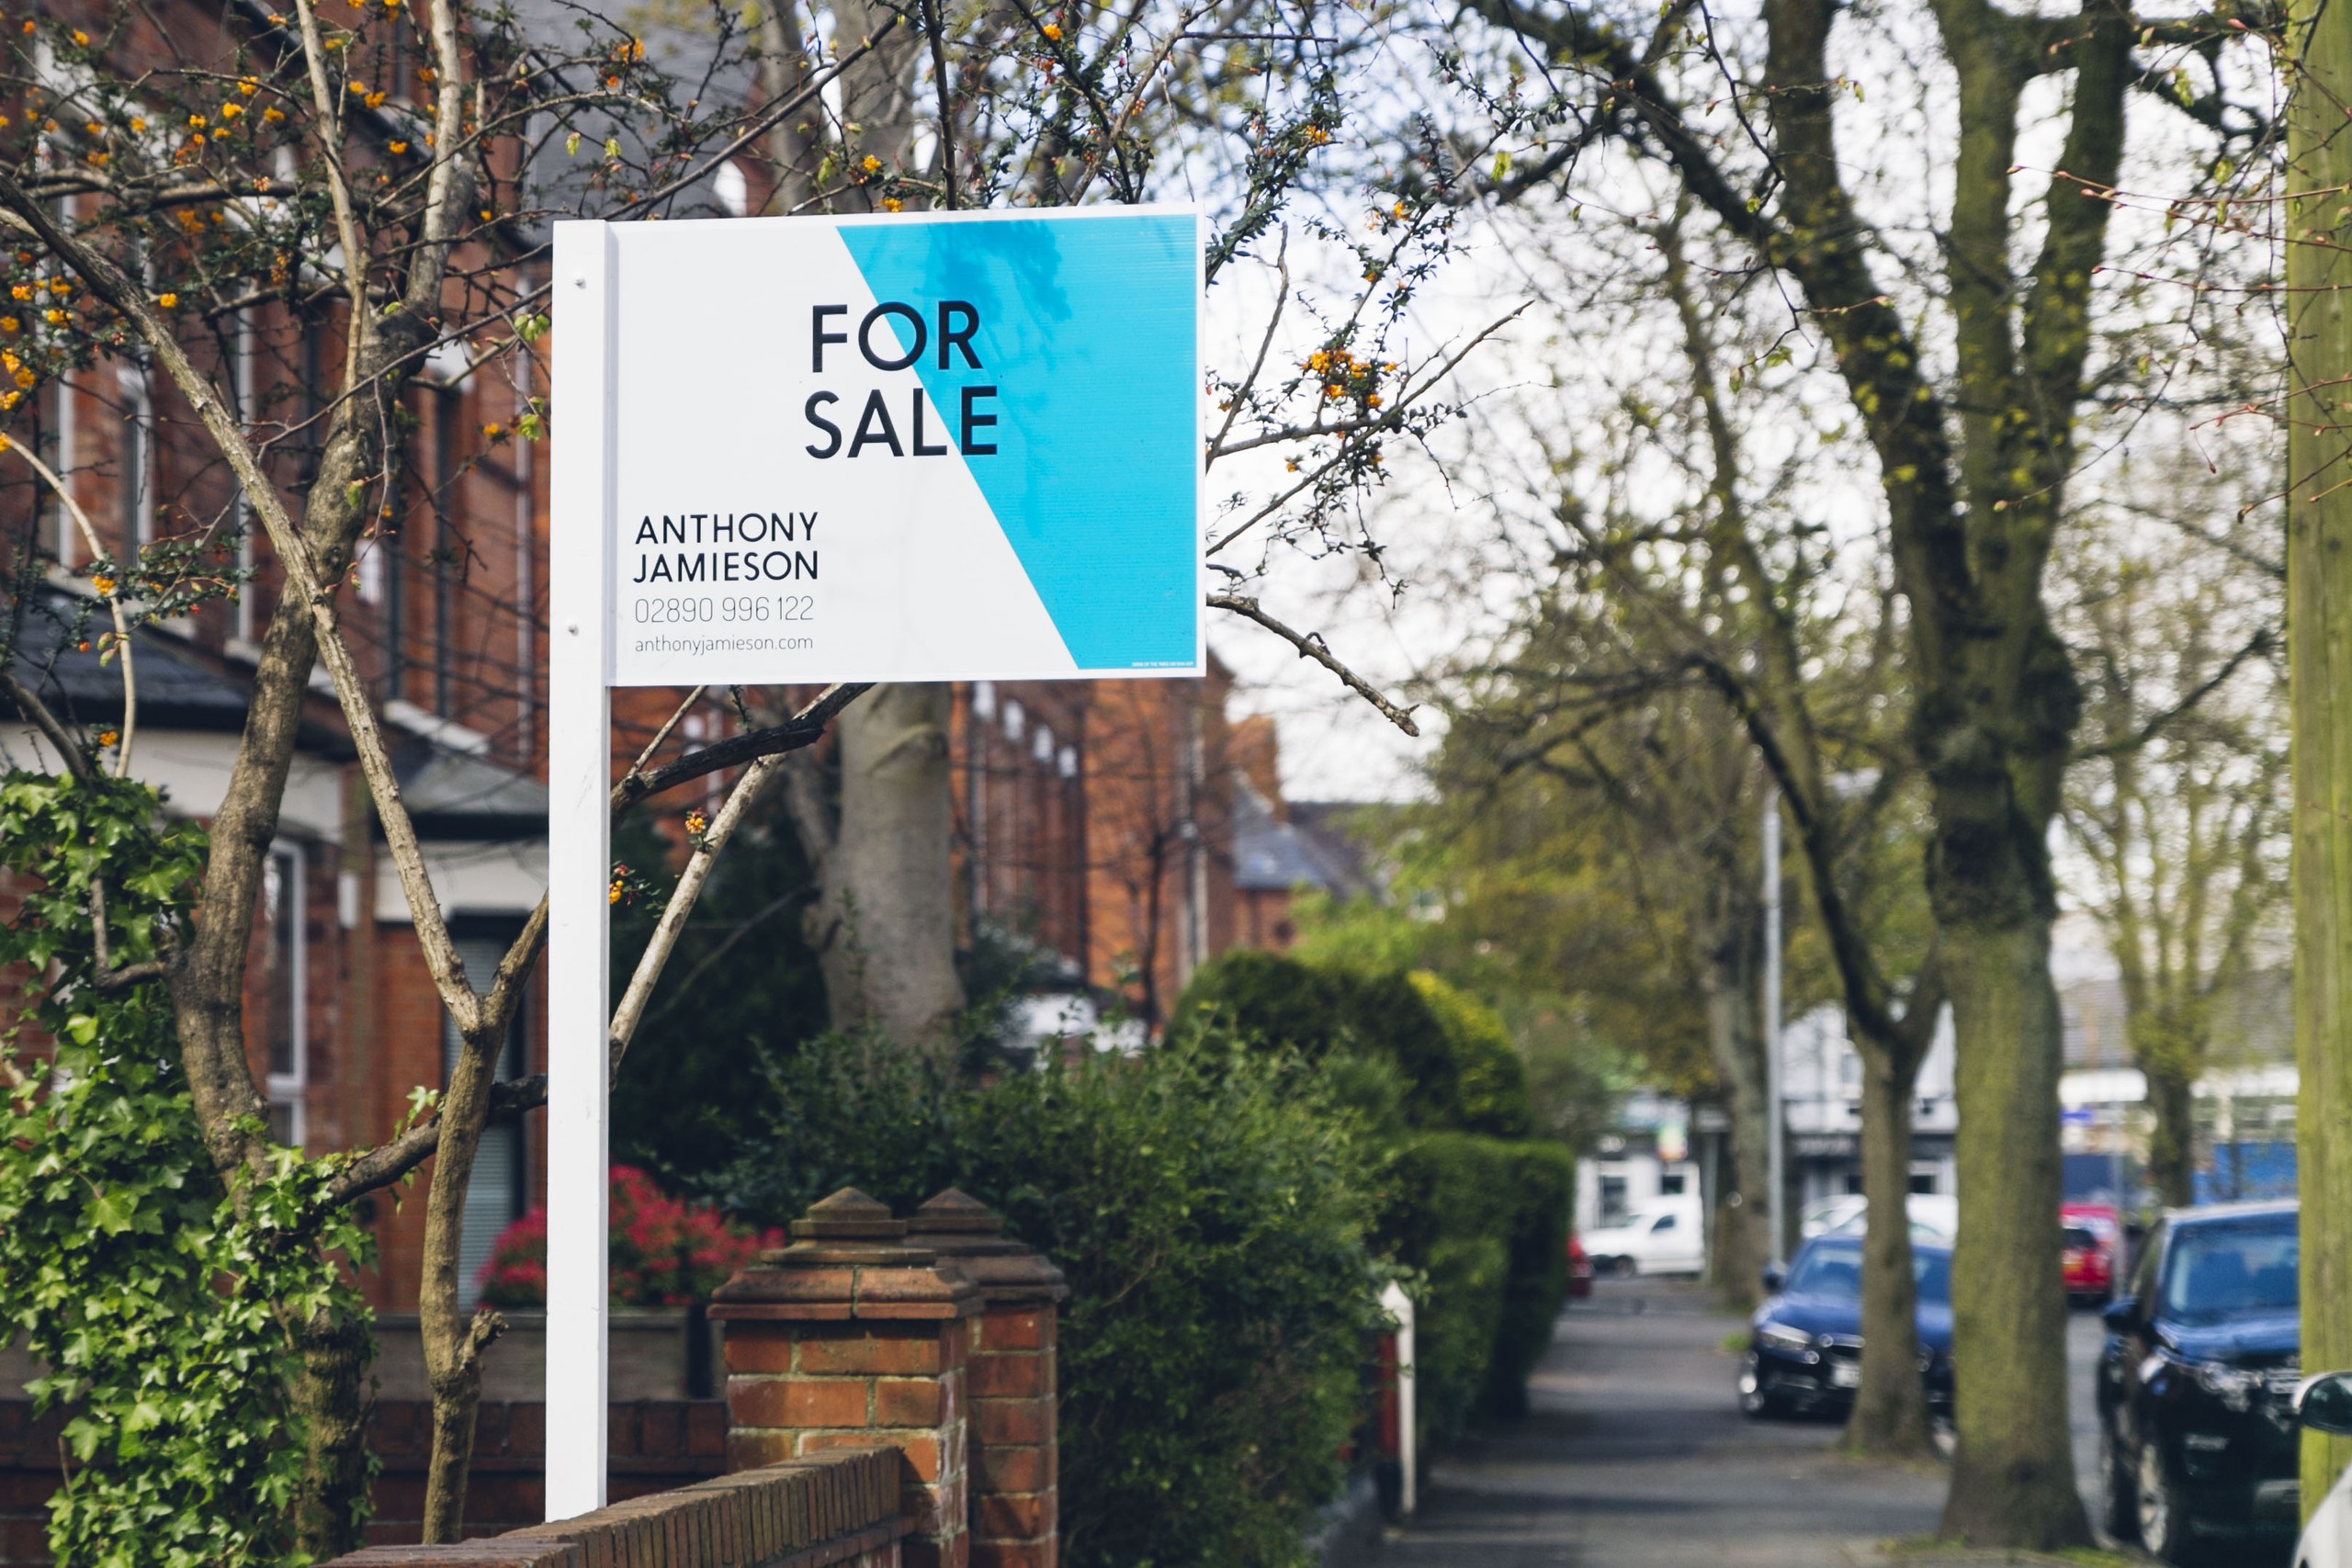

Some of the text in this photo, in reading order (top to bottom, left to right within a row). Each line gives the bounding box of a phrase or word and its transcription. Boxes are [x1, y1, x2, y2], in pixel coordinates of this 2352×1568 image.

[812, 300, 983, 373] FOR
[805, 386, 998, 459] SALE
[635, 512, 819, 544] ANTHONY
[633, 550, 819, 583] JAMIESON
[635, 595, 814, 623] 02890 996 122
[635, 634, 814, 656] anthonyjamieson.com
